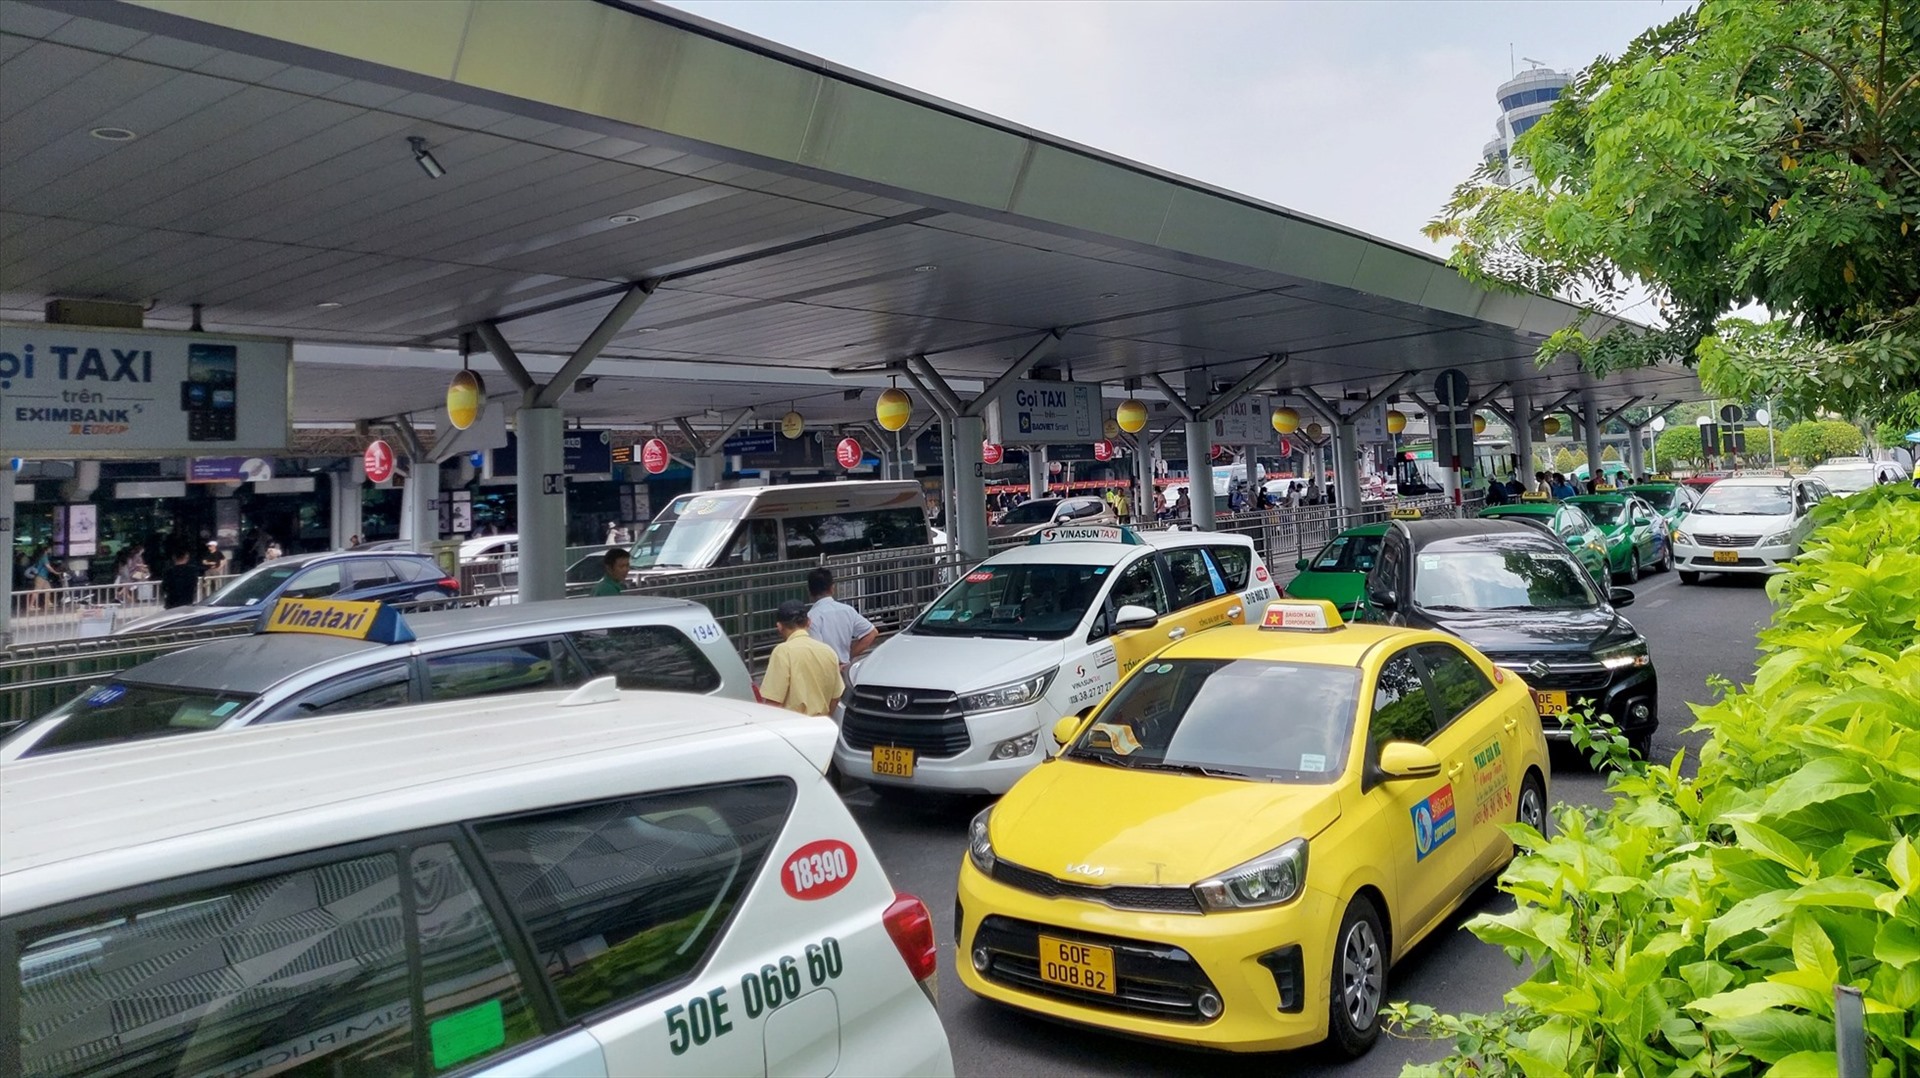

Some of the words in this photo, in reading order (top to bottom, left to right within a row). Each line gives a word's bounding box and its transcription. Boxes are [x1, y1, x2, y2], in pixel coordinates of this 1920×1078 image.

[0, 344, 34, 389] ọi
[50, 346, 152, 382] TAXI
[62, 388, 103, 403] trên
[1016, 389, 1038, 412] Gọi
[1040, 390, 1067, 407] TAXI
[16, 407, 129, 422] EXIMBANK
[1060, 529, 1099, 538] VINASUN
[1100, 529, 1117, 538] TAXI
[277, 602, 369, 631] Vinataxi
[693, 623, 720, 641] 1941
[1538, 693, 1552, 704] 0E
[884, 749, 902, 761] 51G
[877, 761, 908, 776] 603.81
[789, 848, 848, 892] 18390
[1060, 944, 1091, 966] 60E
[1048, 962, 1106, 990] 008.82
[664, 985, 733, 1056] 50E
[741, 955, 802, 1019] 066
[804, 937, 843, 986] 60
